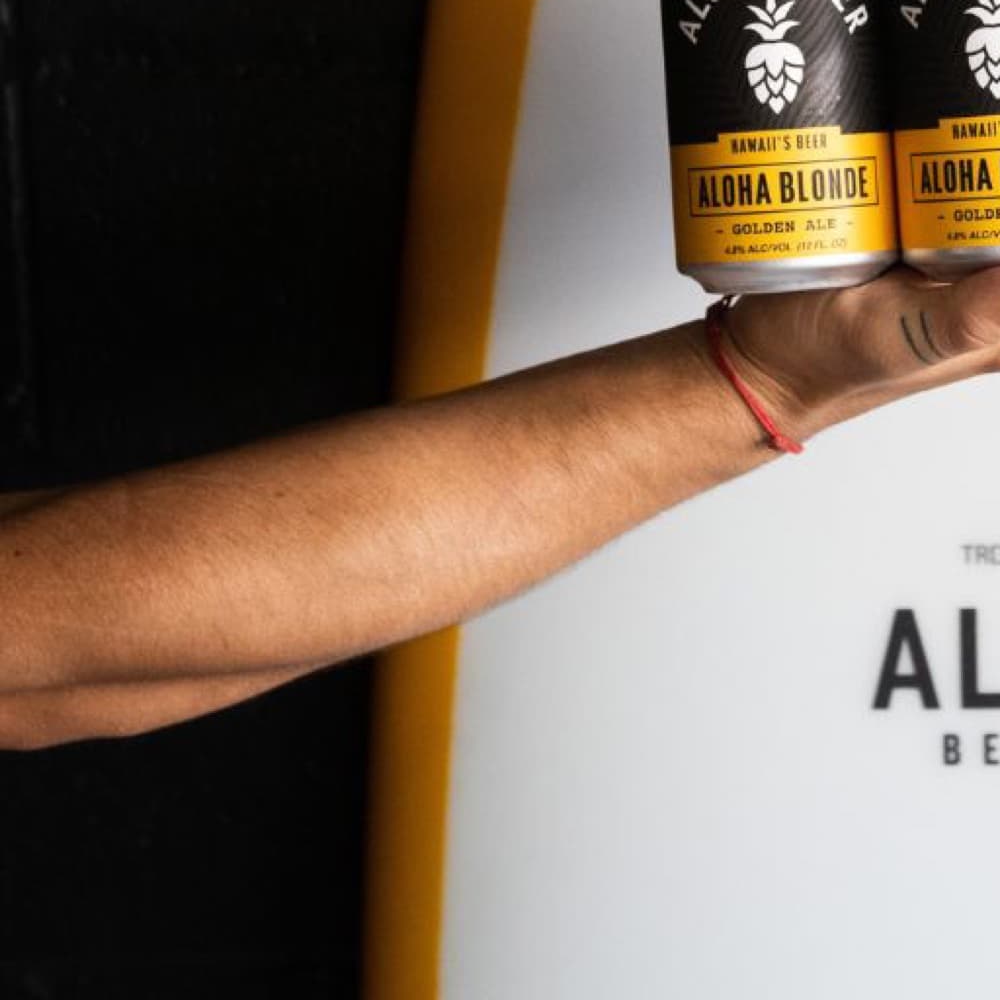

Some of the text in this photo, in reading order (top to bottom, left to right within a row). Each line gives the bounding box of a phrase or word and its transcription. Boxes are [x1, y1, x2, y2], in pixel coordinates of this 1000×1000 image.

[731, 134, 827, 154] HAWAII'S BEER
[699, 166, 869, 208] ALOHA BLONDE
[921, 158, 993, 193] ALOHA
[732, 219, 836, 235] GOLDEN ALE
